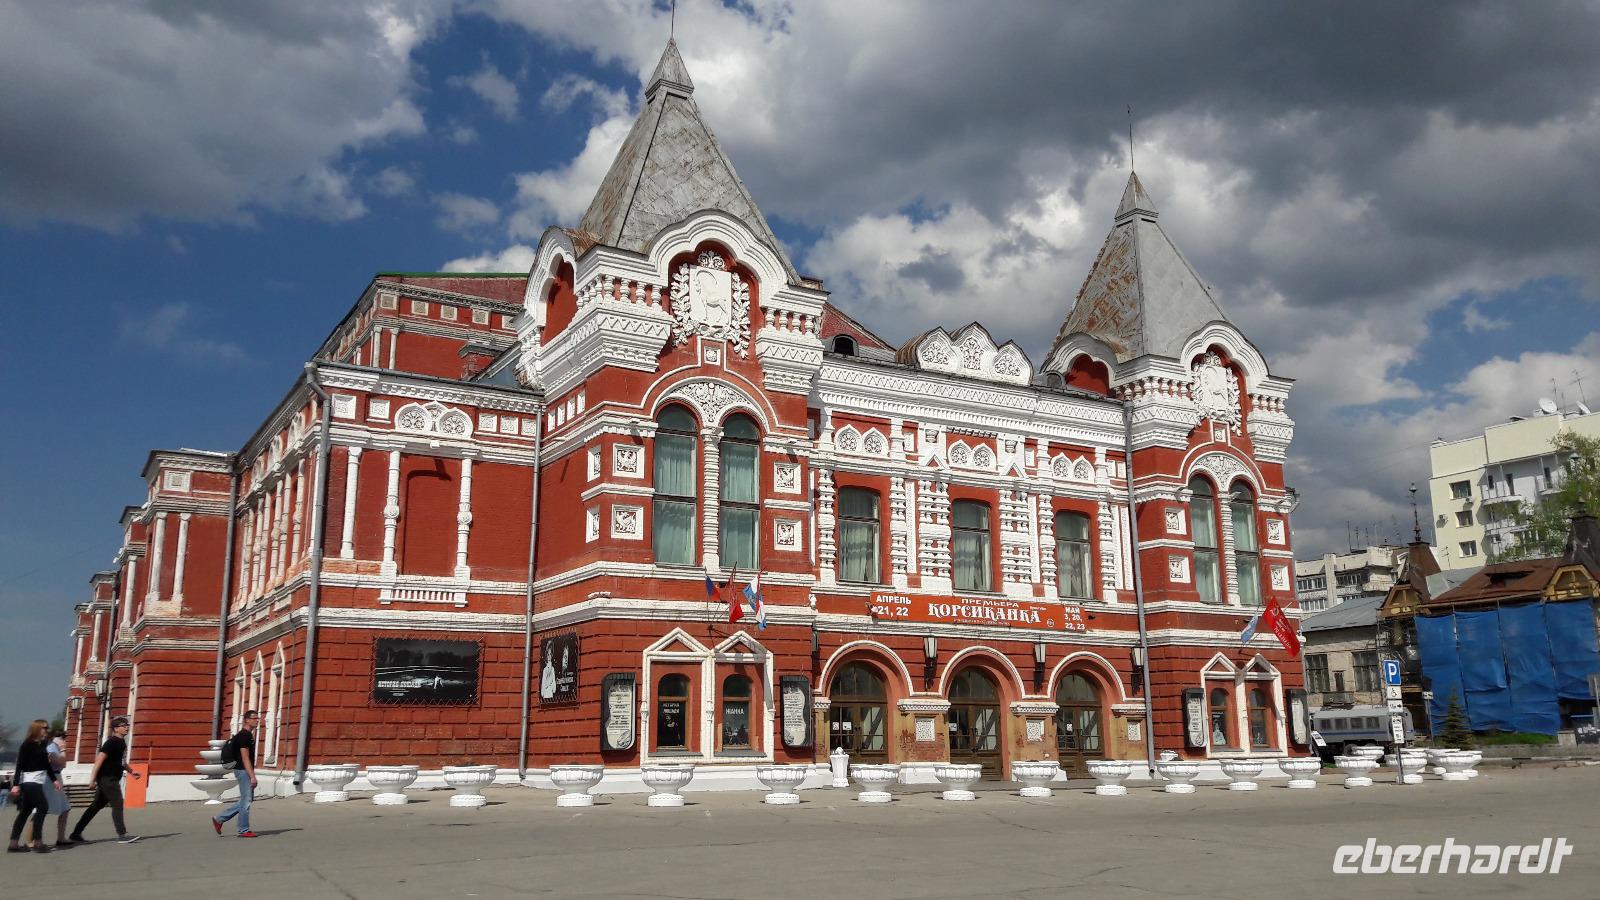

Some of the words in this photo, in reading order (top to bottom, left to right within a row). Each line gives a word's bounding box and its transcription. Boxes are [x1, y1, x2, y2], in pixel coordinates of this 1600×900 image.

[876, 594, 912, 605] АПРЕЛЬ
[961, 598, 1020, 608] ПРЕМЬЕРА
[877, 605, 893, 618] 21,
[896, 606, 909, 617] 22
[927, 603, 1042, 624] КОРСИКАНКА
[1065, 606, 1081, 614] МАЙ
[1072, 613, 1083, 623] 20,
[1064, 622, 1076, 631] 22,
[1387, 662, 1398, 683] P
